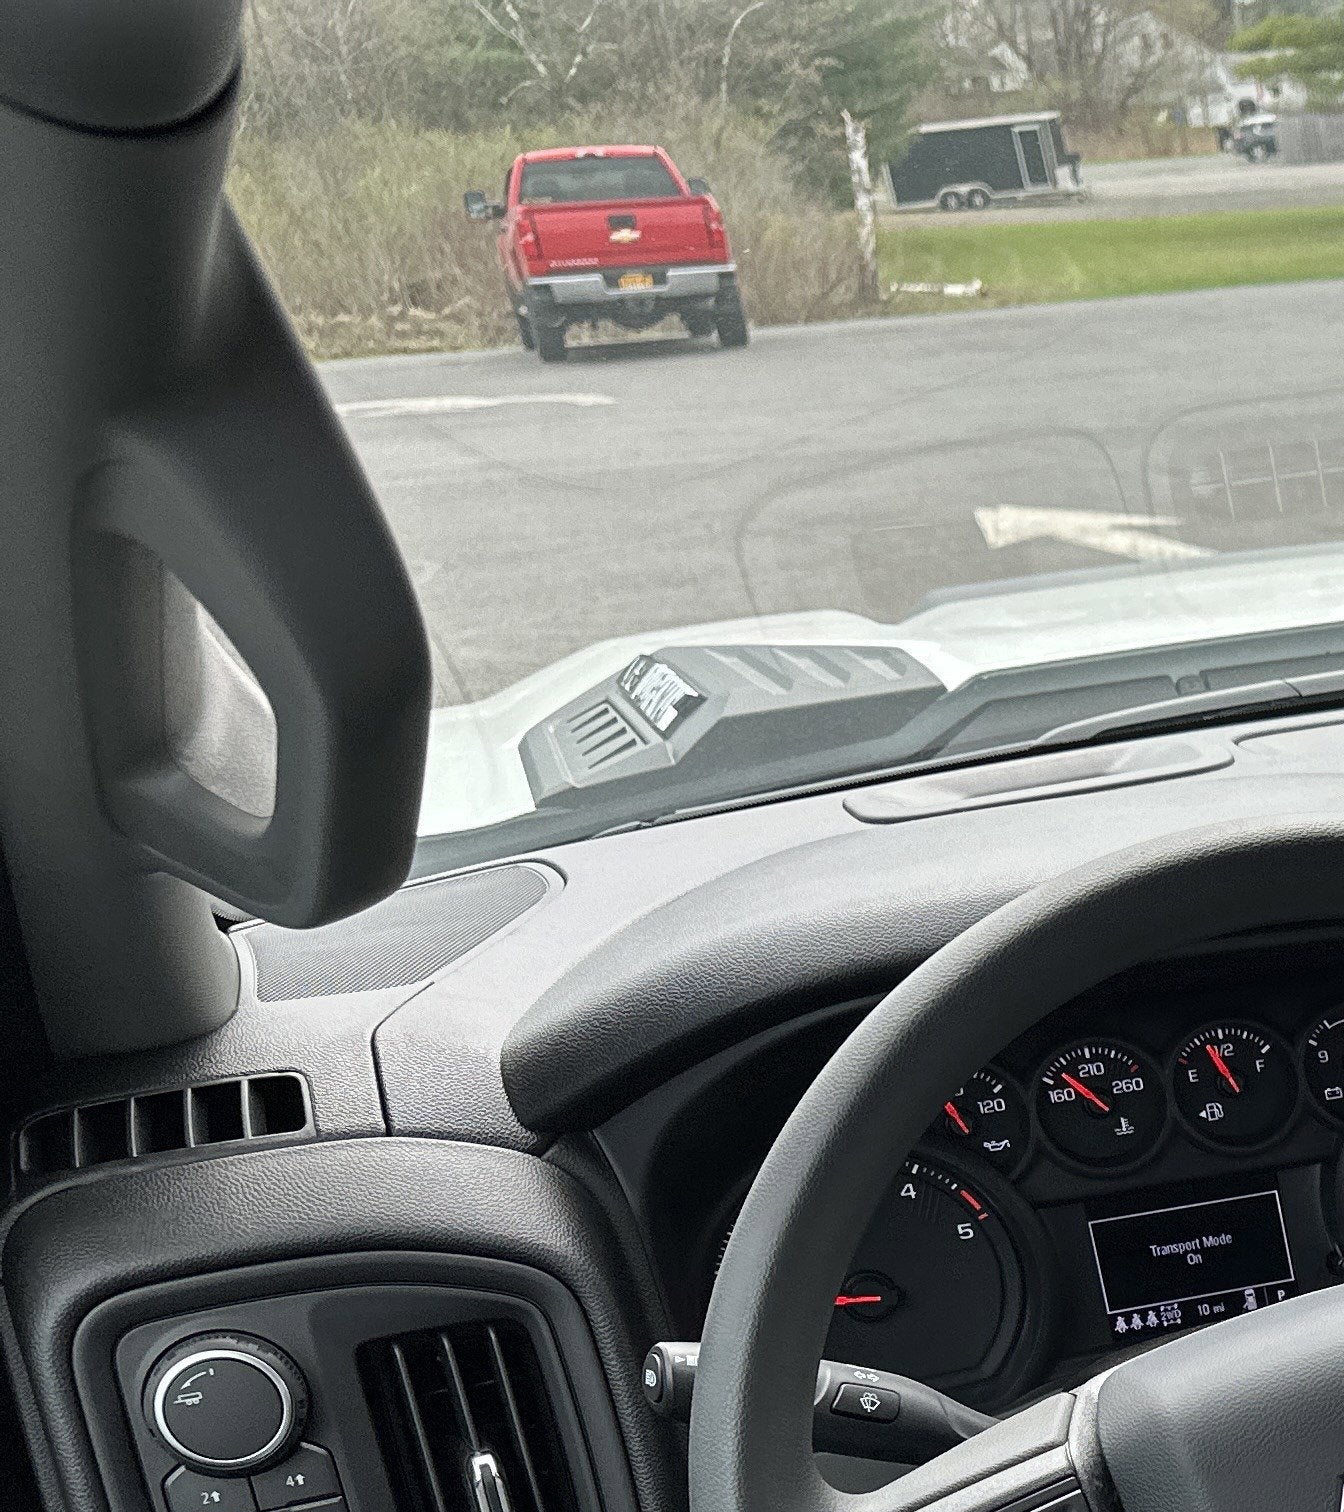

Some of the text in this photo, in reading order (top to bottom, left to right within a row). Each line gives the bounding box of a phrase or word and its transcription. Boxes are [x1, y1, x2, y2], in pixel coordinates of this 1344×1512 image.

[1317, 1050, 1329, 1063] 9
[1078, 1062, 1105, 1078] 210
[1255, 1059, 1265, 1072] F
[1188, 1069, 1199, 1083] E
[1112, 1077, 1144, 1094] 260
[1048, 1087, 1075, 1104] 160
[977, 1098, 1006, 1114] 120
[900, 1183, 917, 1199] 4
[957, 1223, 974, 1239] 5
[1150, 1233, 1233, 1257] Transport Mode
[1186, 1253, 1203, 1265] On
[1197, 1303, 1210, 1317] 10
[1213, 1302, 1225, 1314] mi
[1277, 1289, 1286, 1301] P
